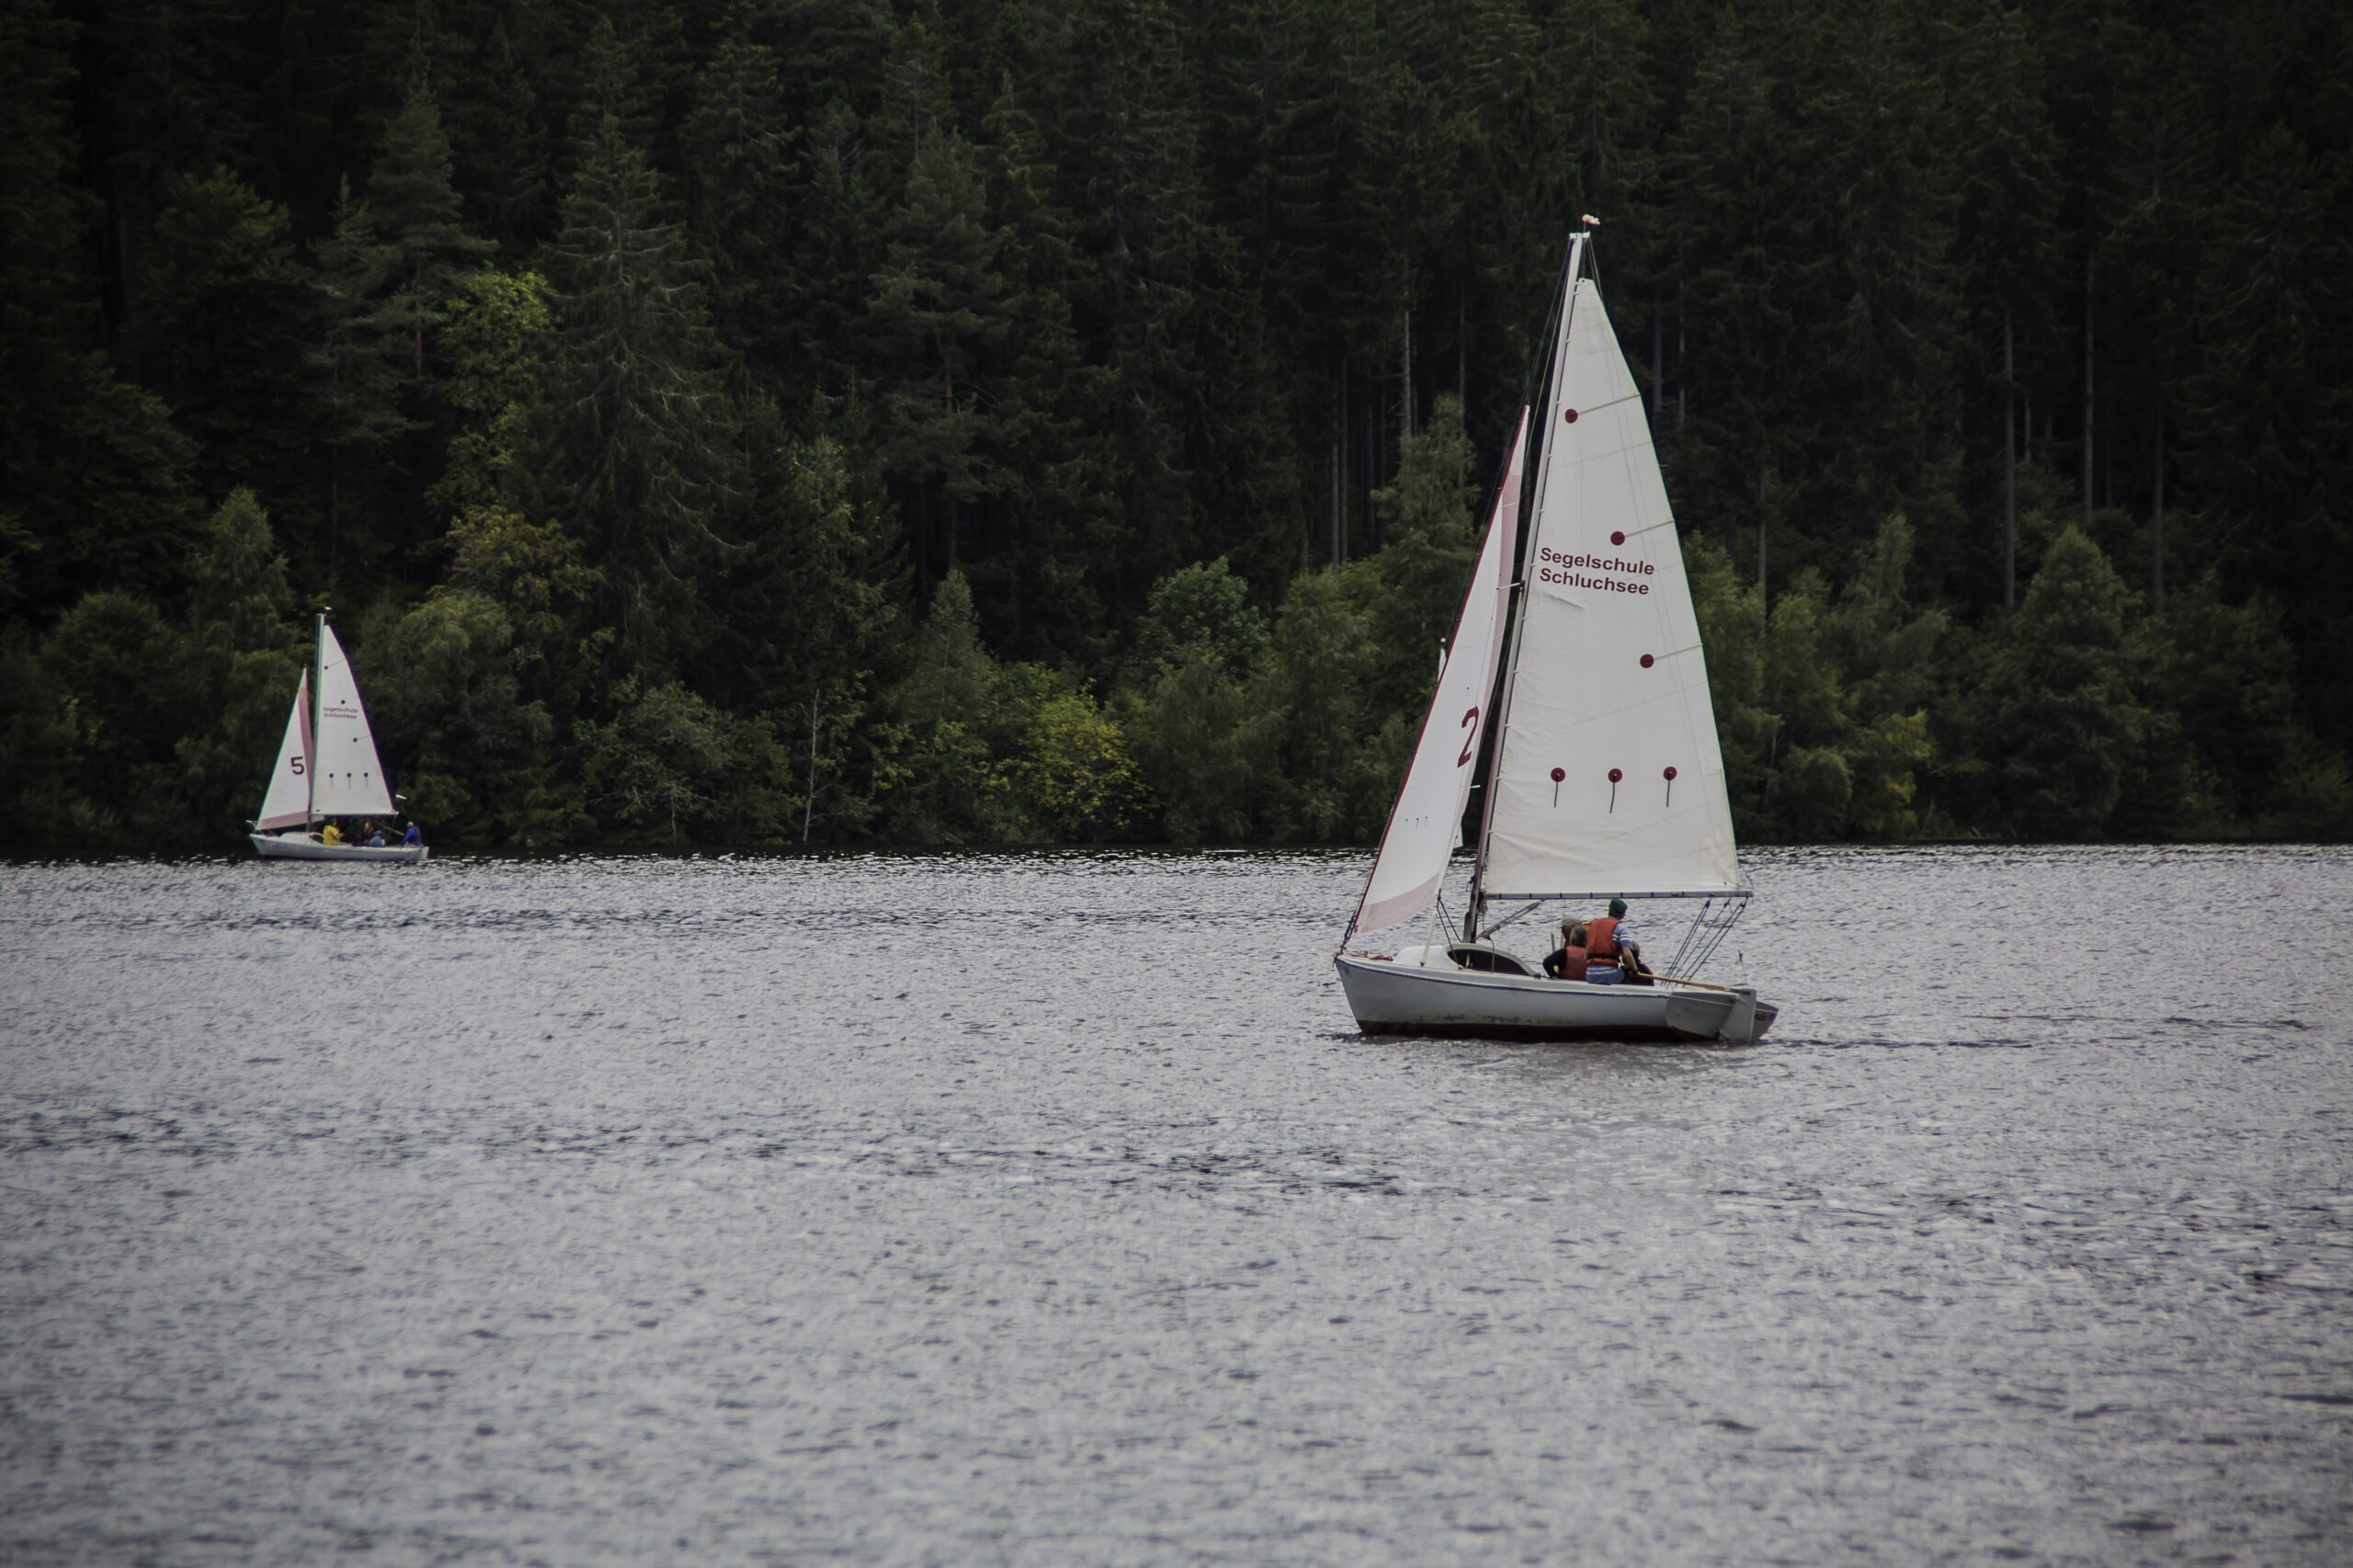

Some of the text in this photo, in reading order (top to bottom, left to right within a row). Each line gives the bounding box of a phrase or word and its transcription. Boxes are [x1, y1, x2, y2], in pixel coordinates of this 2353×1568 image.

[1540, 547, 1654, 575] Segelschule
[1540, 568, 1649, 595] Schluchsee
[1457, 706, 1480, 768] 2
[290, 756, 304, 776] 5
